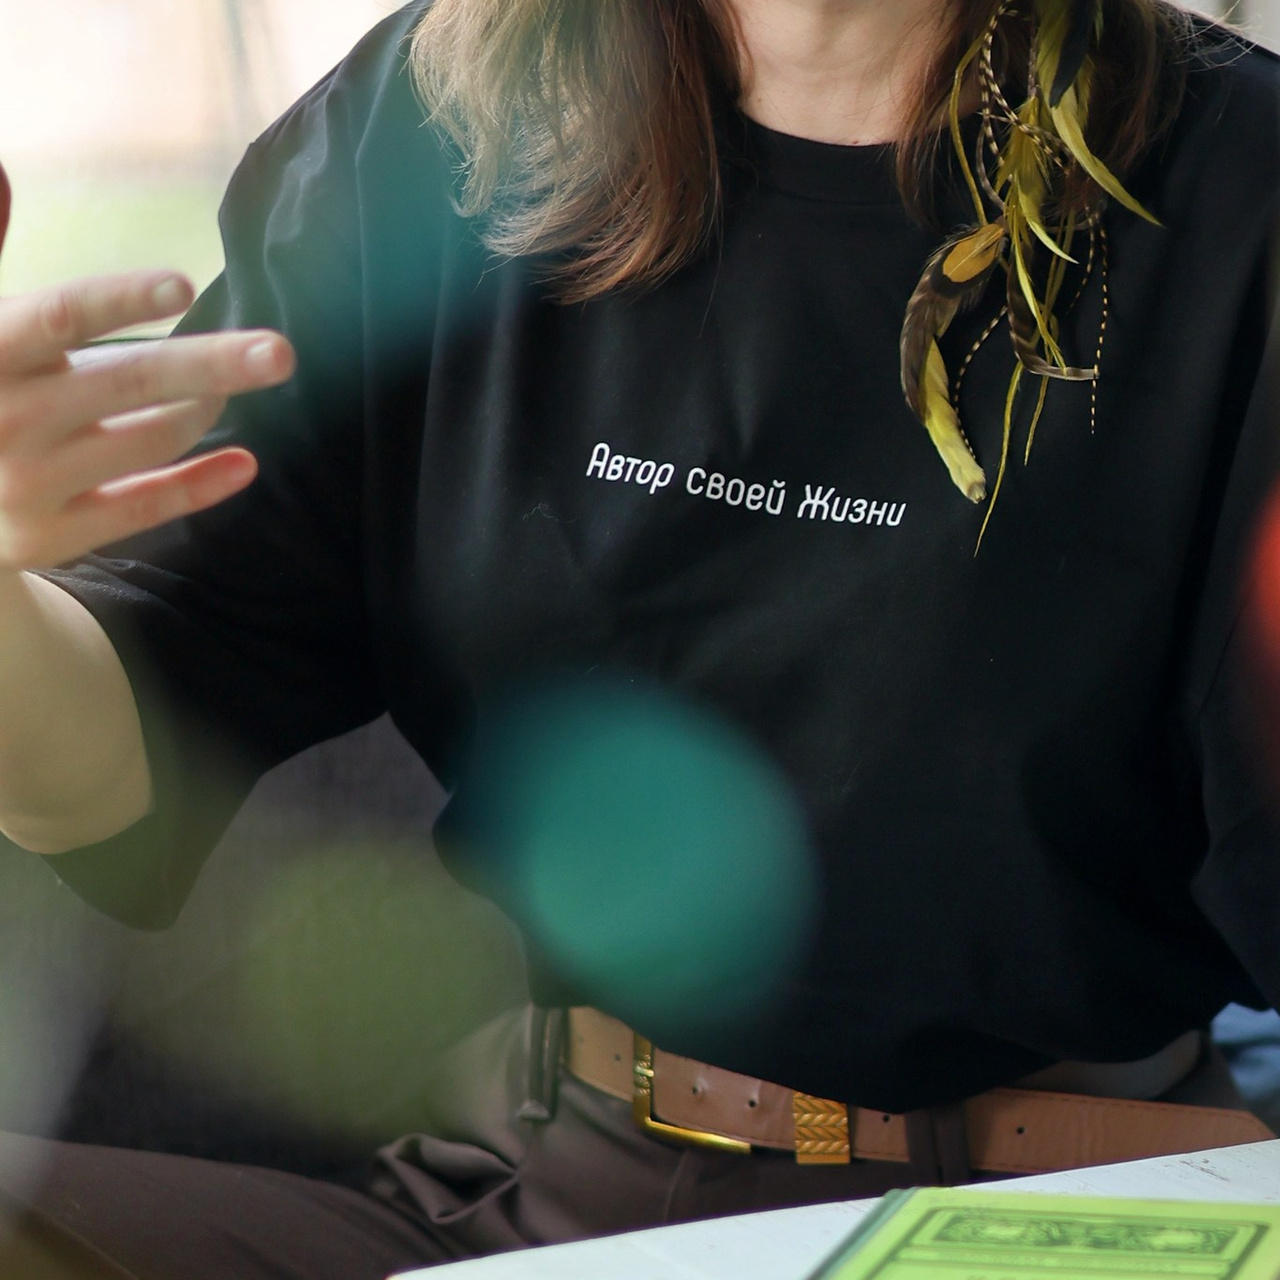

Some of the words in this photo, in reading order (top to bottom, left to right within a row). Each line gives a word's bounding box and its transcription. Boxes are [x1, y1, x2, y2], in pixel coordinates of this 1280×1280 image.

[585, 442, 675, 495] Автор
[686, 467, 786, 515] своей
[796, 484, 907, 527] Жизни
